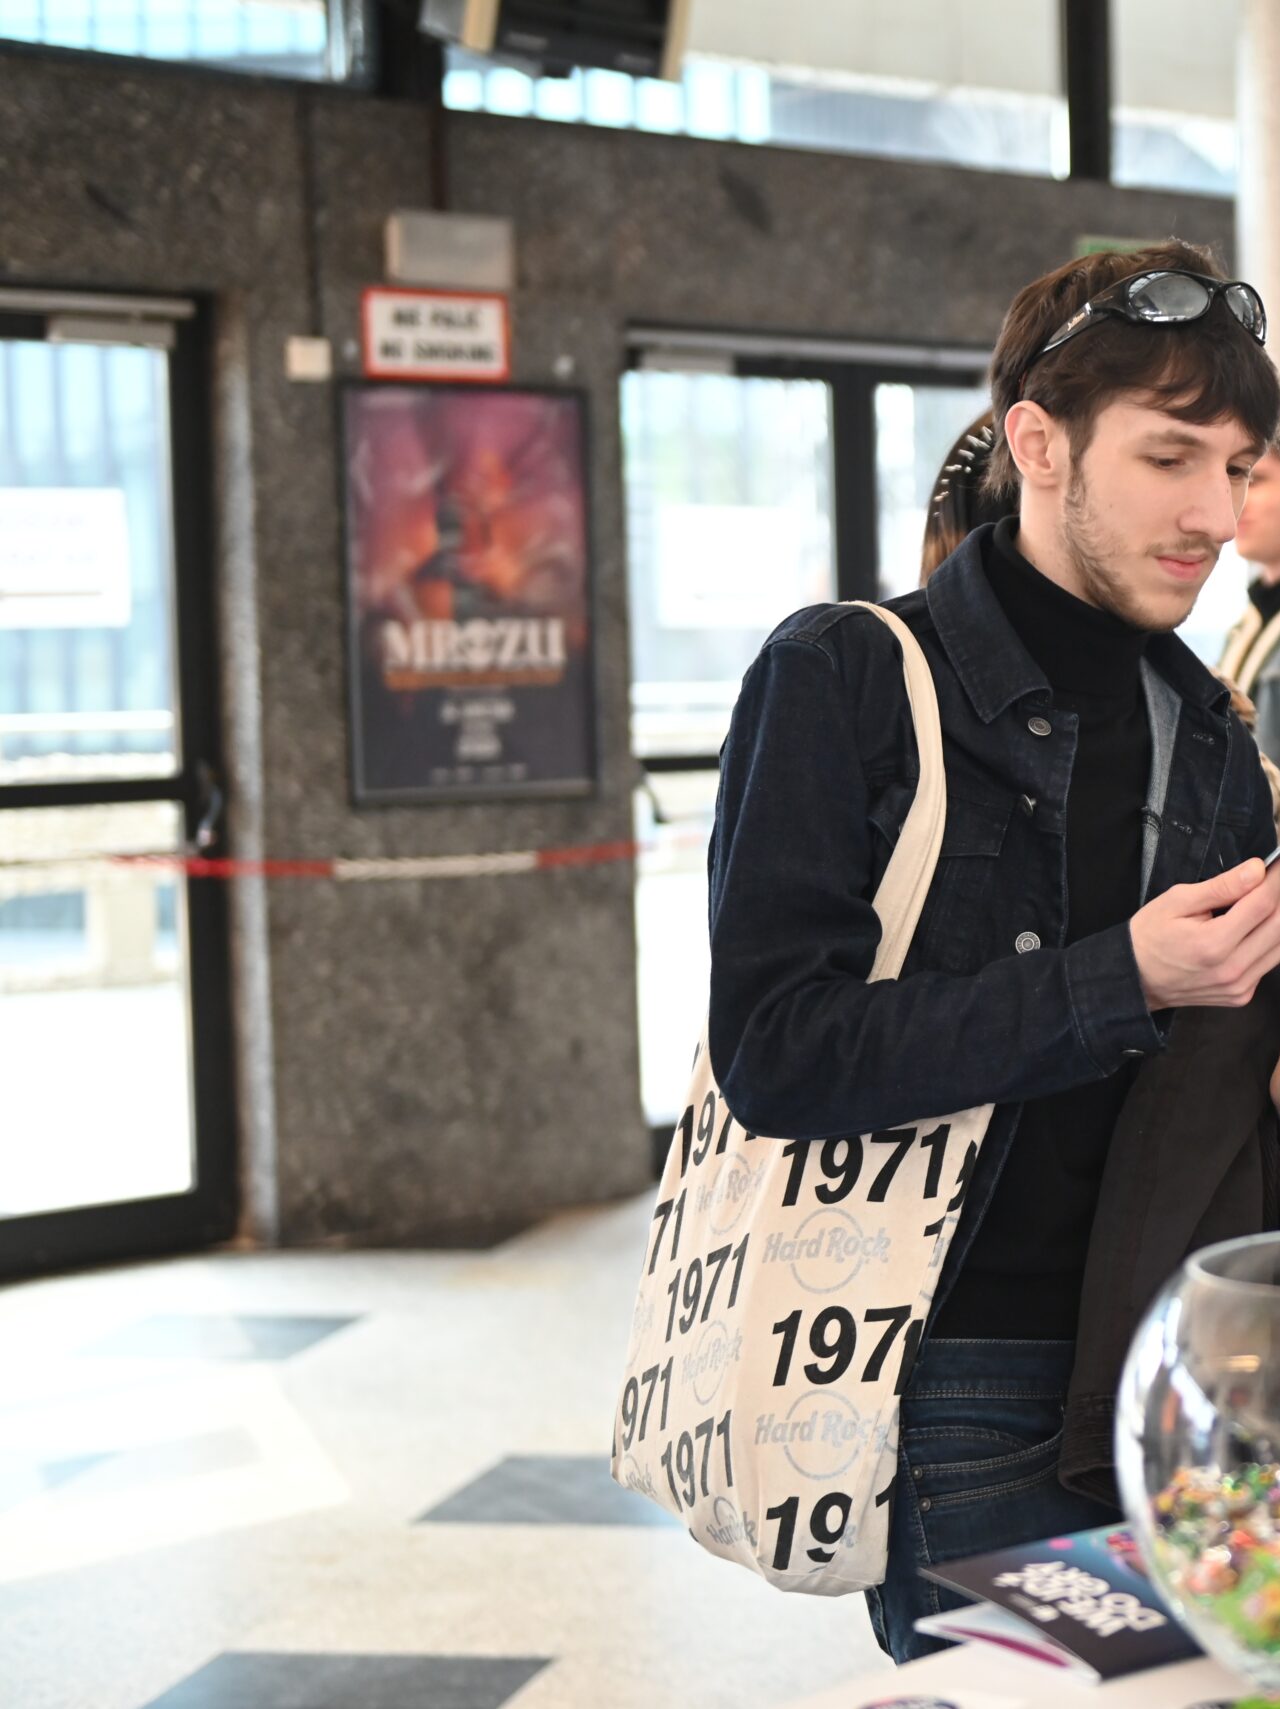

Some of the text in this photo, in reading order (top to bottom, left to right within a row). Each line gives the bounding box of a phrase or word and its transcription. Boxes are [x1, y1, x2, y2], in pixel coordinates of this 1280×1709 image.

[384, 617, 566, 671] MROZU
[782, 1123, 951, 1207] 1971
[761, 1228, 826, 1264] Hard
[824, 1226, 892, 1264] Rock
[665, 1233, 750, 1343] 1971
[612, 1356, 674, 1458] 971
[755, 1410, 819, 1446] Hard
[661, 1410, 733, 1513] 1971
